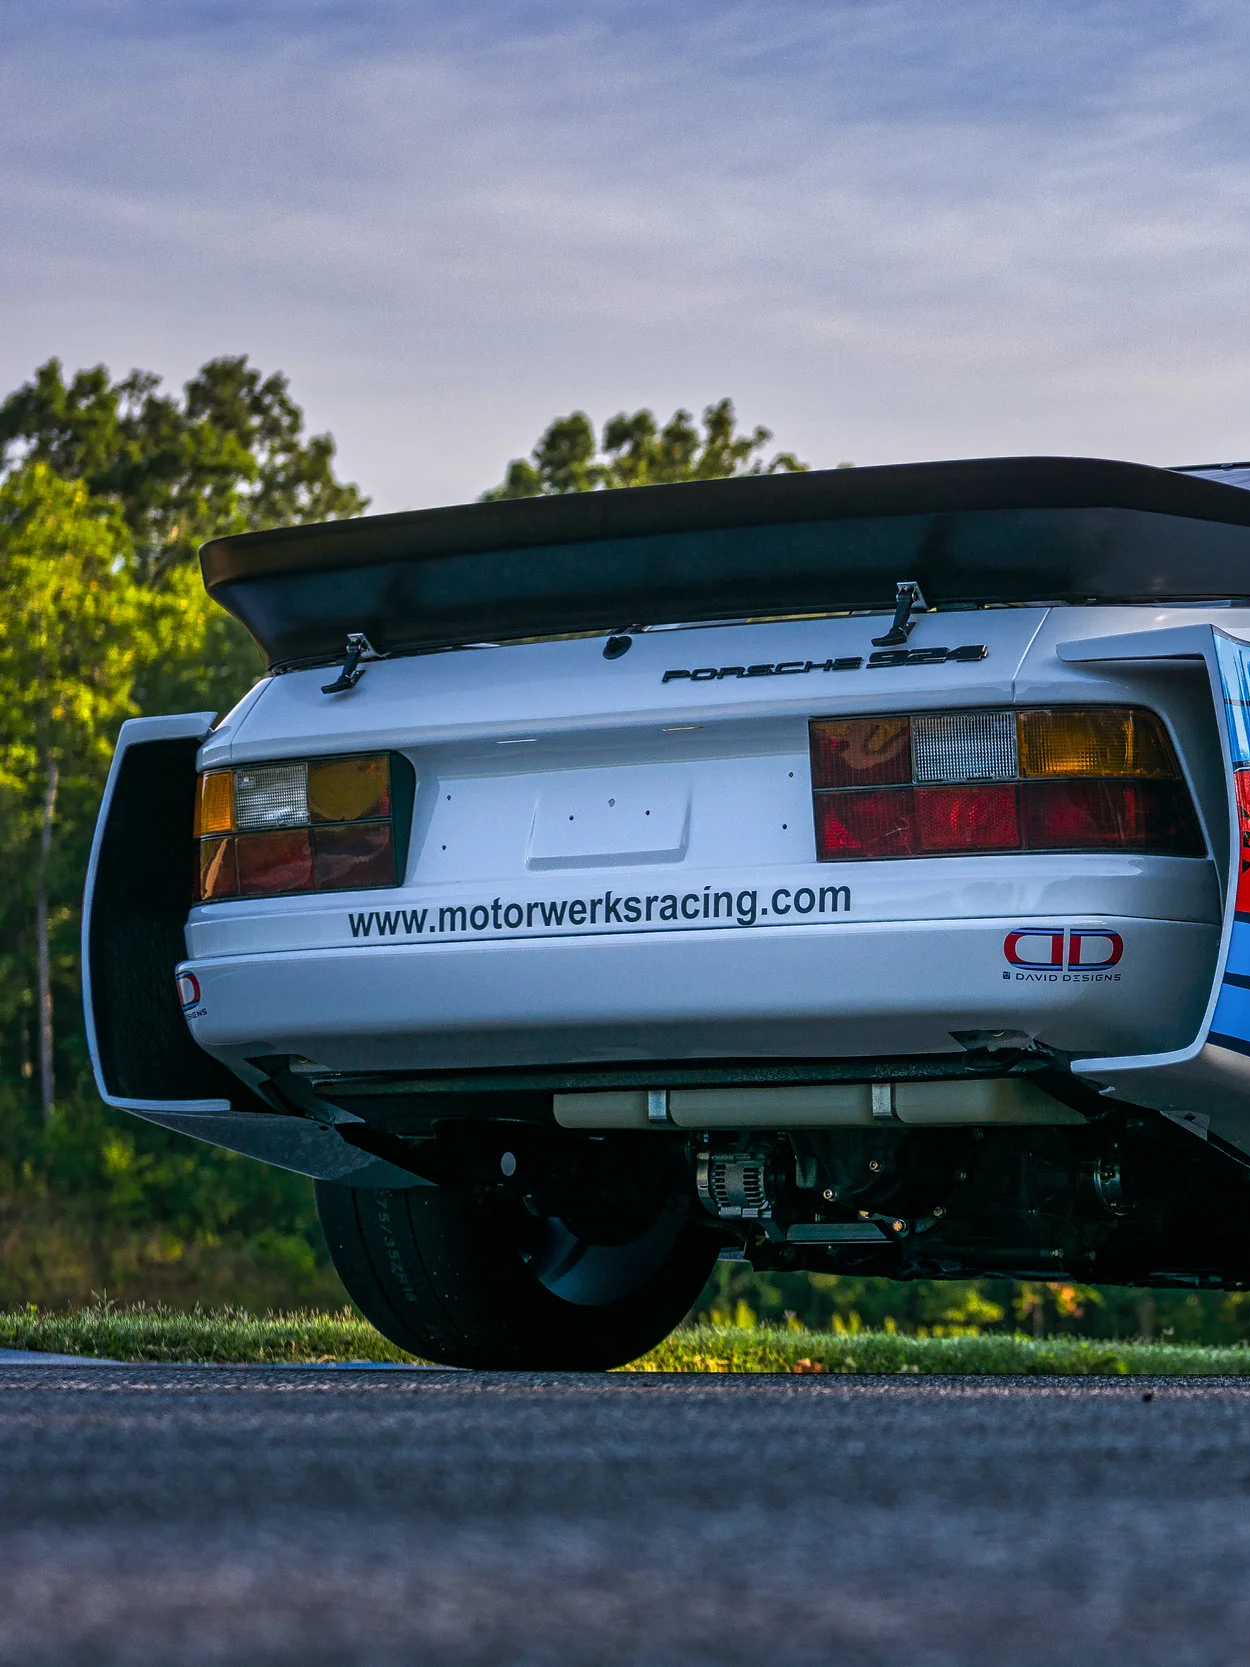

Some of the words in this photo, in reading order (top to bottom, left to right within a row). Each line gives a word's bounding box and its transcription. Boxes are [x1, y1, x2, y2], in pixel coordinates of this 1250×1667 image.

[661, 656, 863, 683] PORSCHE
[866, 645, 989, 670] 924
[348, 884, 852, 938] www.motorwerksracing.com
[1016, 973, 1058, 982] DAVID
[1063, 973, 1121, 982] DESIGNS
